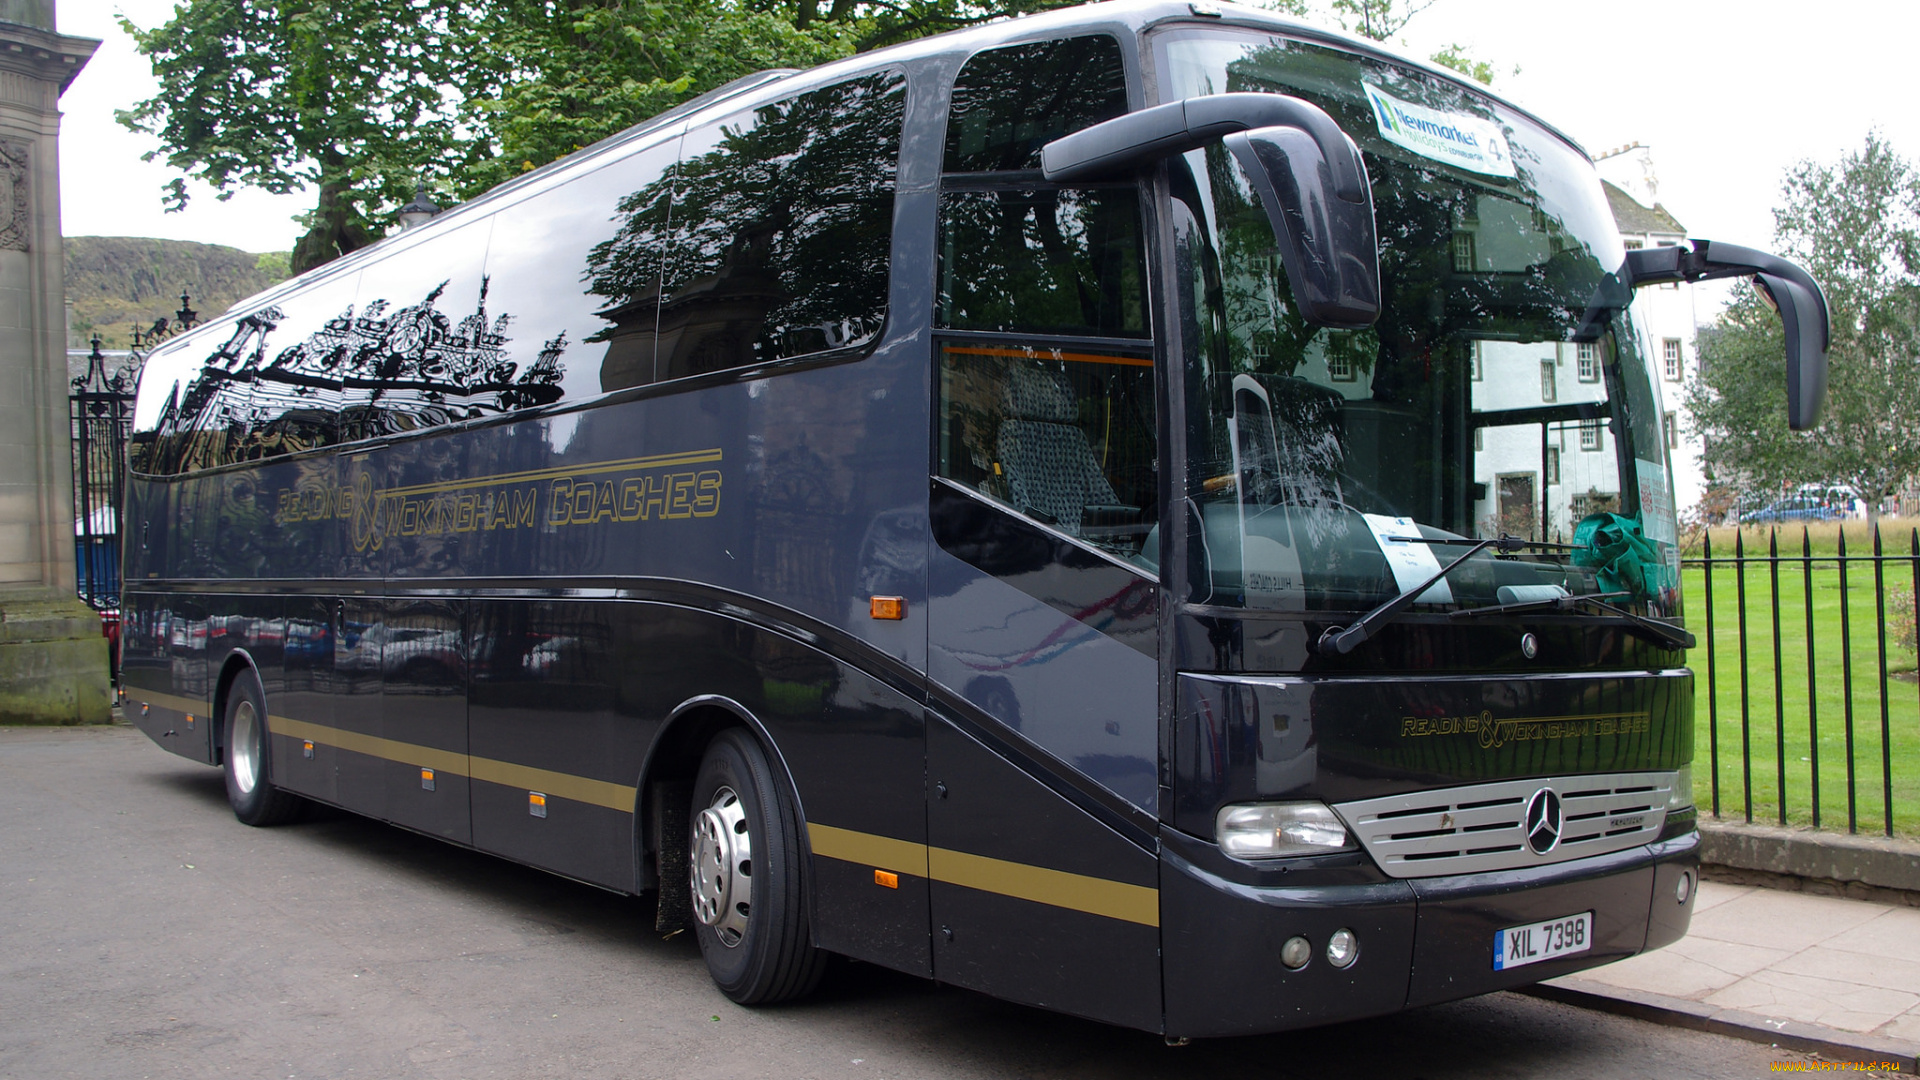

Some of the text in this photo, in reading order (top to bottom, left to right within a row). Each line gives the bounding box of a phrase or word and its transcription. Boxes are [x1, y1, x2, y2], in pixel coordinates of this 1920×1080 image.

[1394, 107, 1503, 161] Newmarket 4
[1402, 128, 1448, 153] Holidays
[275, 470, 722, 551] READING & WOKINGHAM COACHES
[1401, 710, 1649, 748] READING & WOKINGHAM COACHES
[1510, 918, 1584, 960] XIL 7398
